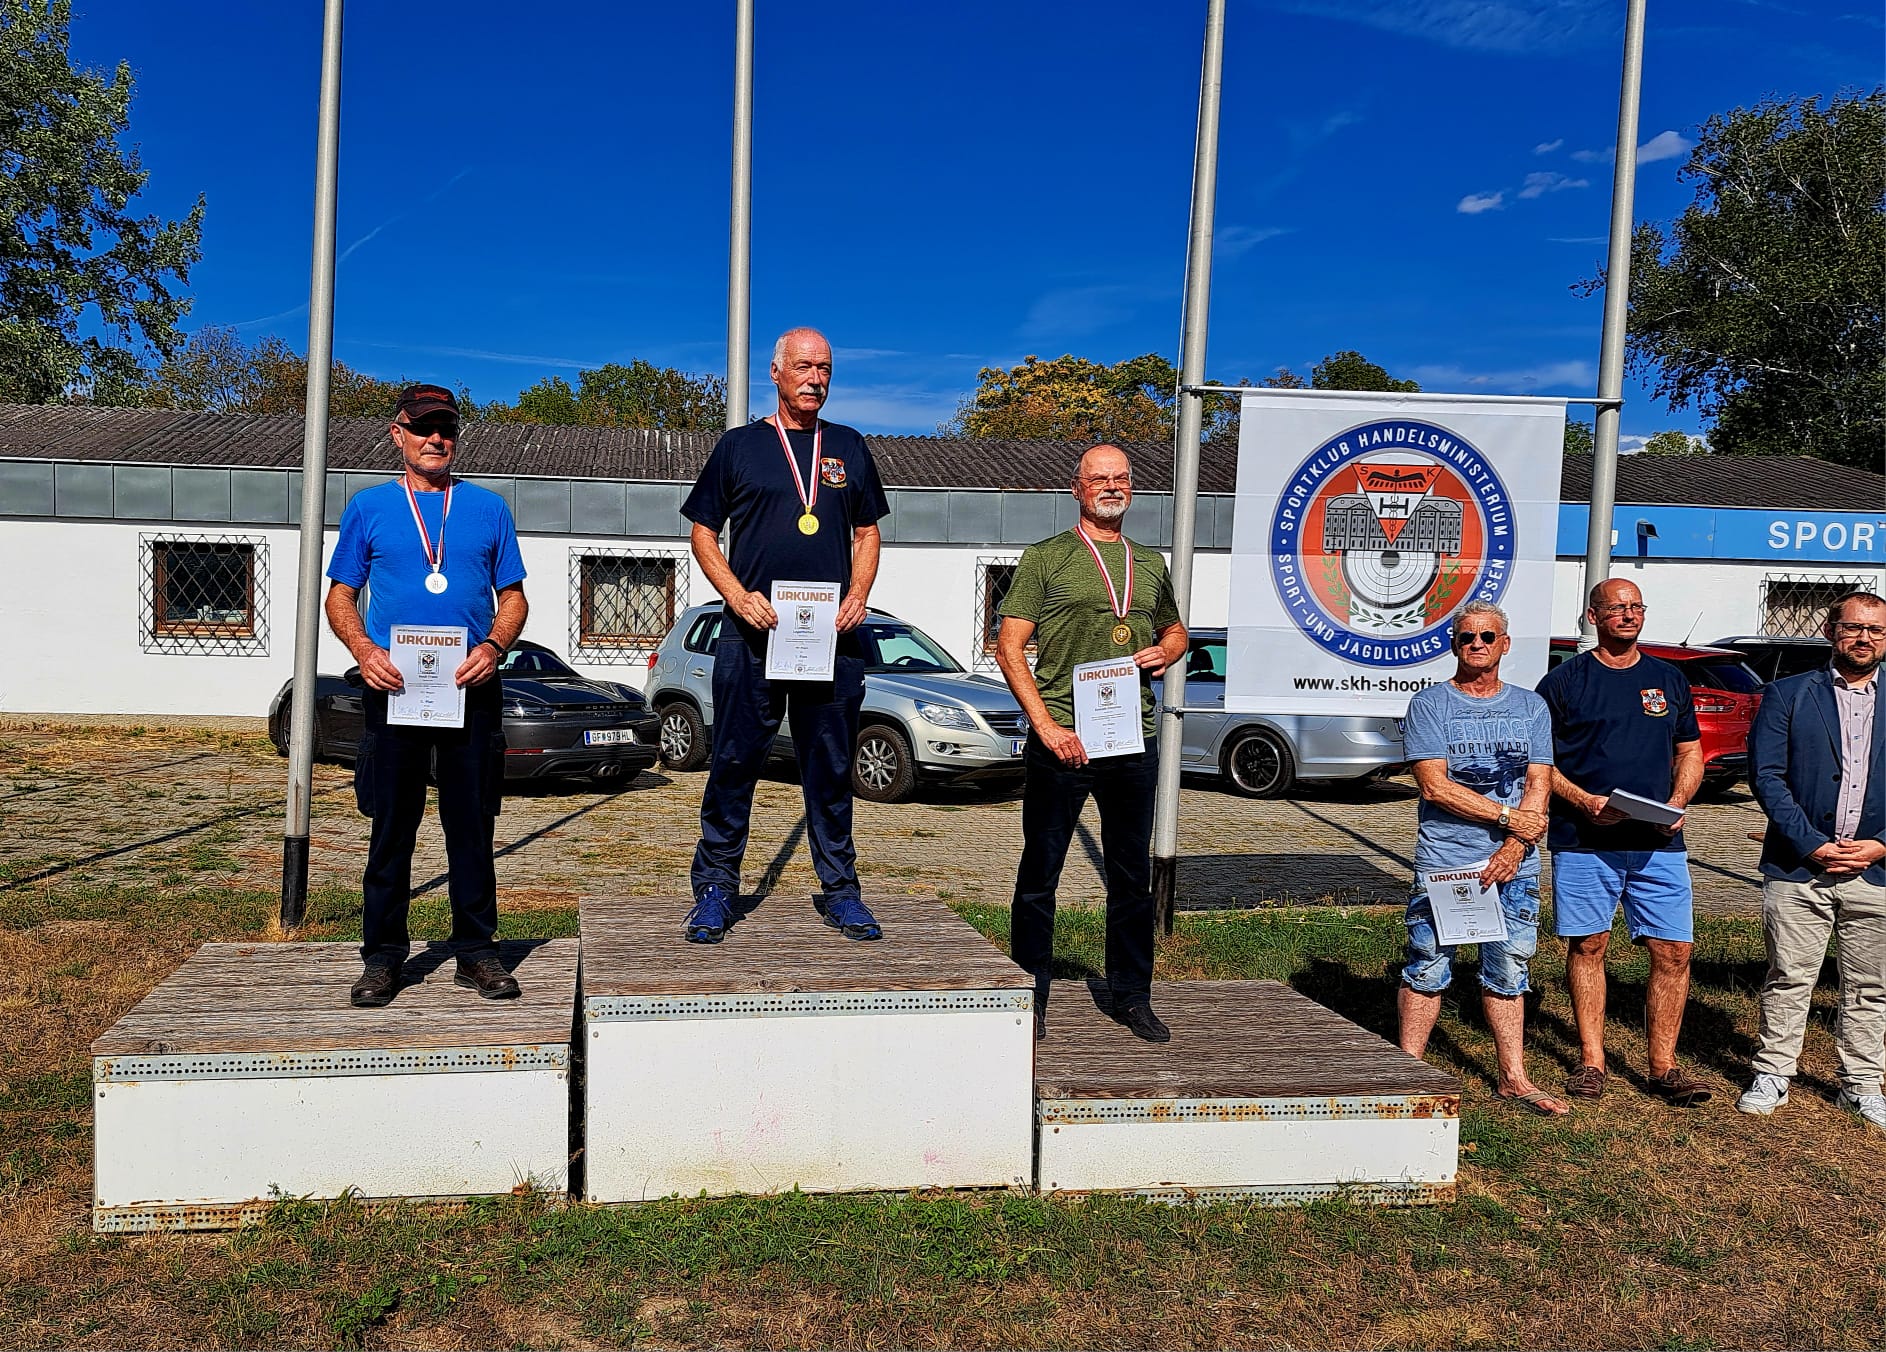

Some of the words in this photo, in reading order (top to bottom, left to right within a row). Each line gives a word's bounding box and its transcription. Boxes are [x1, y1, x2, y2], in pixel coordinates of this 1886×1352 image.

[1360, 466, 1369, 475] S
[1426, 468, 1436, 477] K
[1280, 441, 1350, 531] SPORTKLUB
[1358, 428, 1508, 536] HANDELSMINISTERIUM
[1769, 520, 1886, 551] SPOR
[777, 590, 835, 602] URKUNDE
[396, 634, 462, 647] URKUNDE
[1339, 636, 1442, 661] JAGDLICHES
[1079, 666, 1135, 682] URKUNDE
[1293, 676, 1443, 692] www.skh-shooti
[1447, 741, 1529, 755] NORTHWARD
[1429, 871, 1481, 883] URKUND
